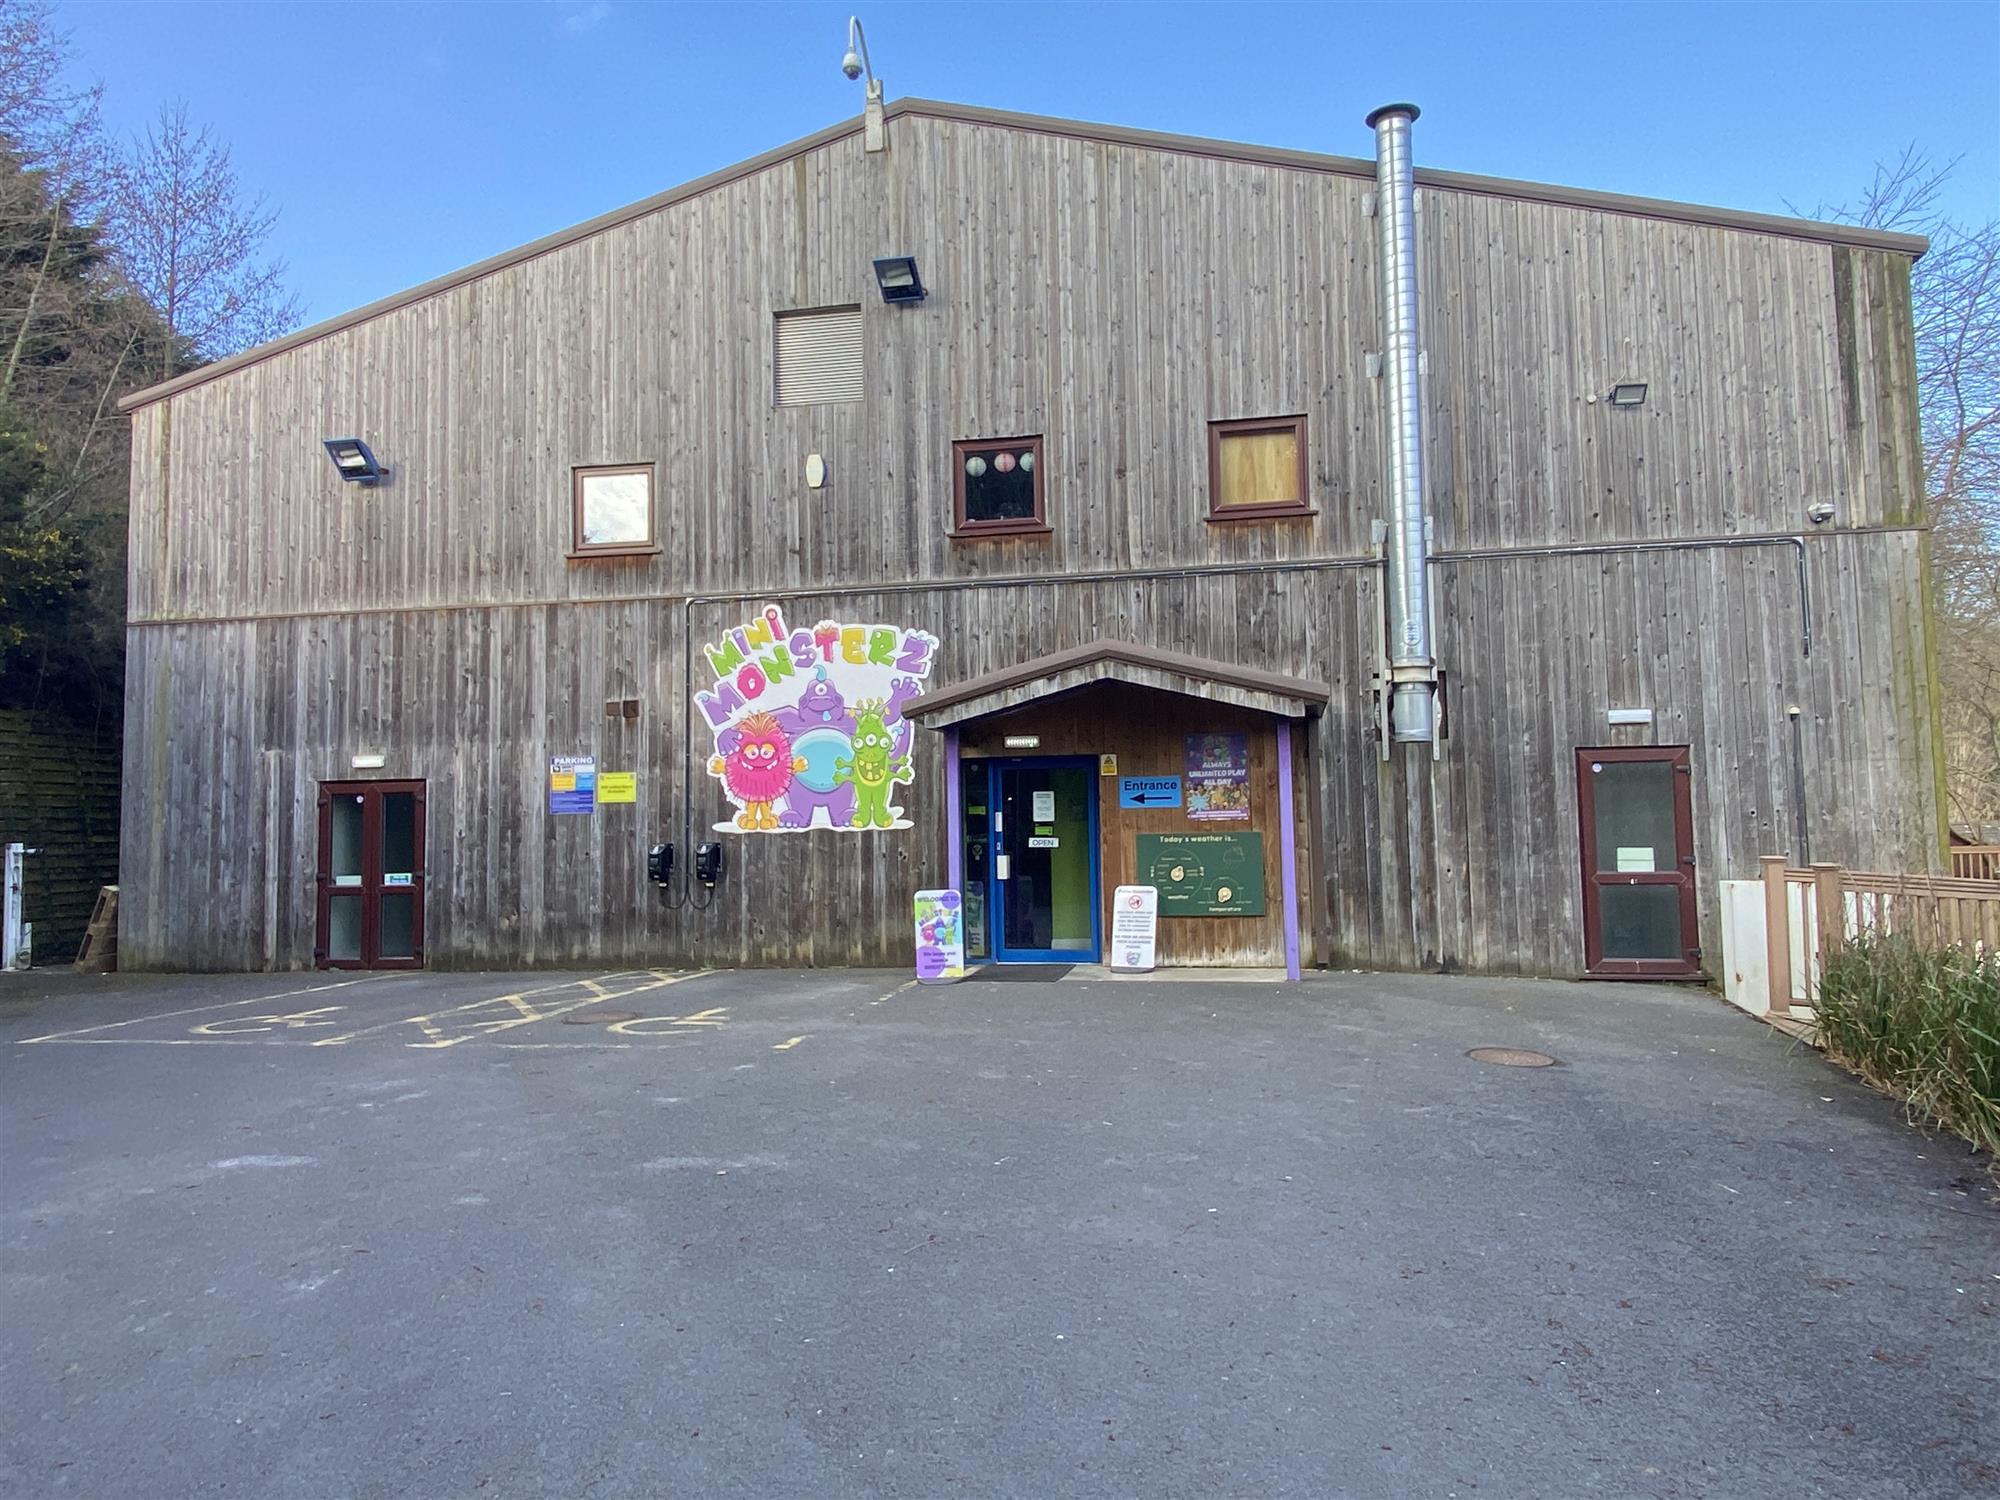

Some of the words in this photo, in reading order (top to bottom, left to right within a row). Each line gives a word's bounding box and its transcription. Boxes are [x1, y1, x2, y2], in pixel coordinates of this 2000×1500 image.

[706, 608, 785, 677] MINI
[698, 621, 936, 727] MONSTERZ
[554, 757, 593, 765] PARKING
[1124, 780, 1177, 791] Entrance
[1032, 839, 1054, 847] OPEN
[1160, 835, 1189, 843] Todays
